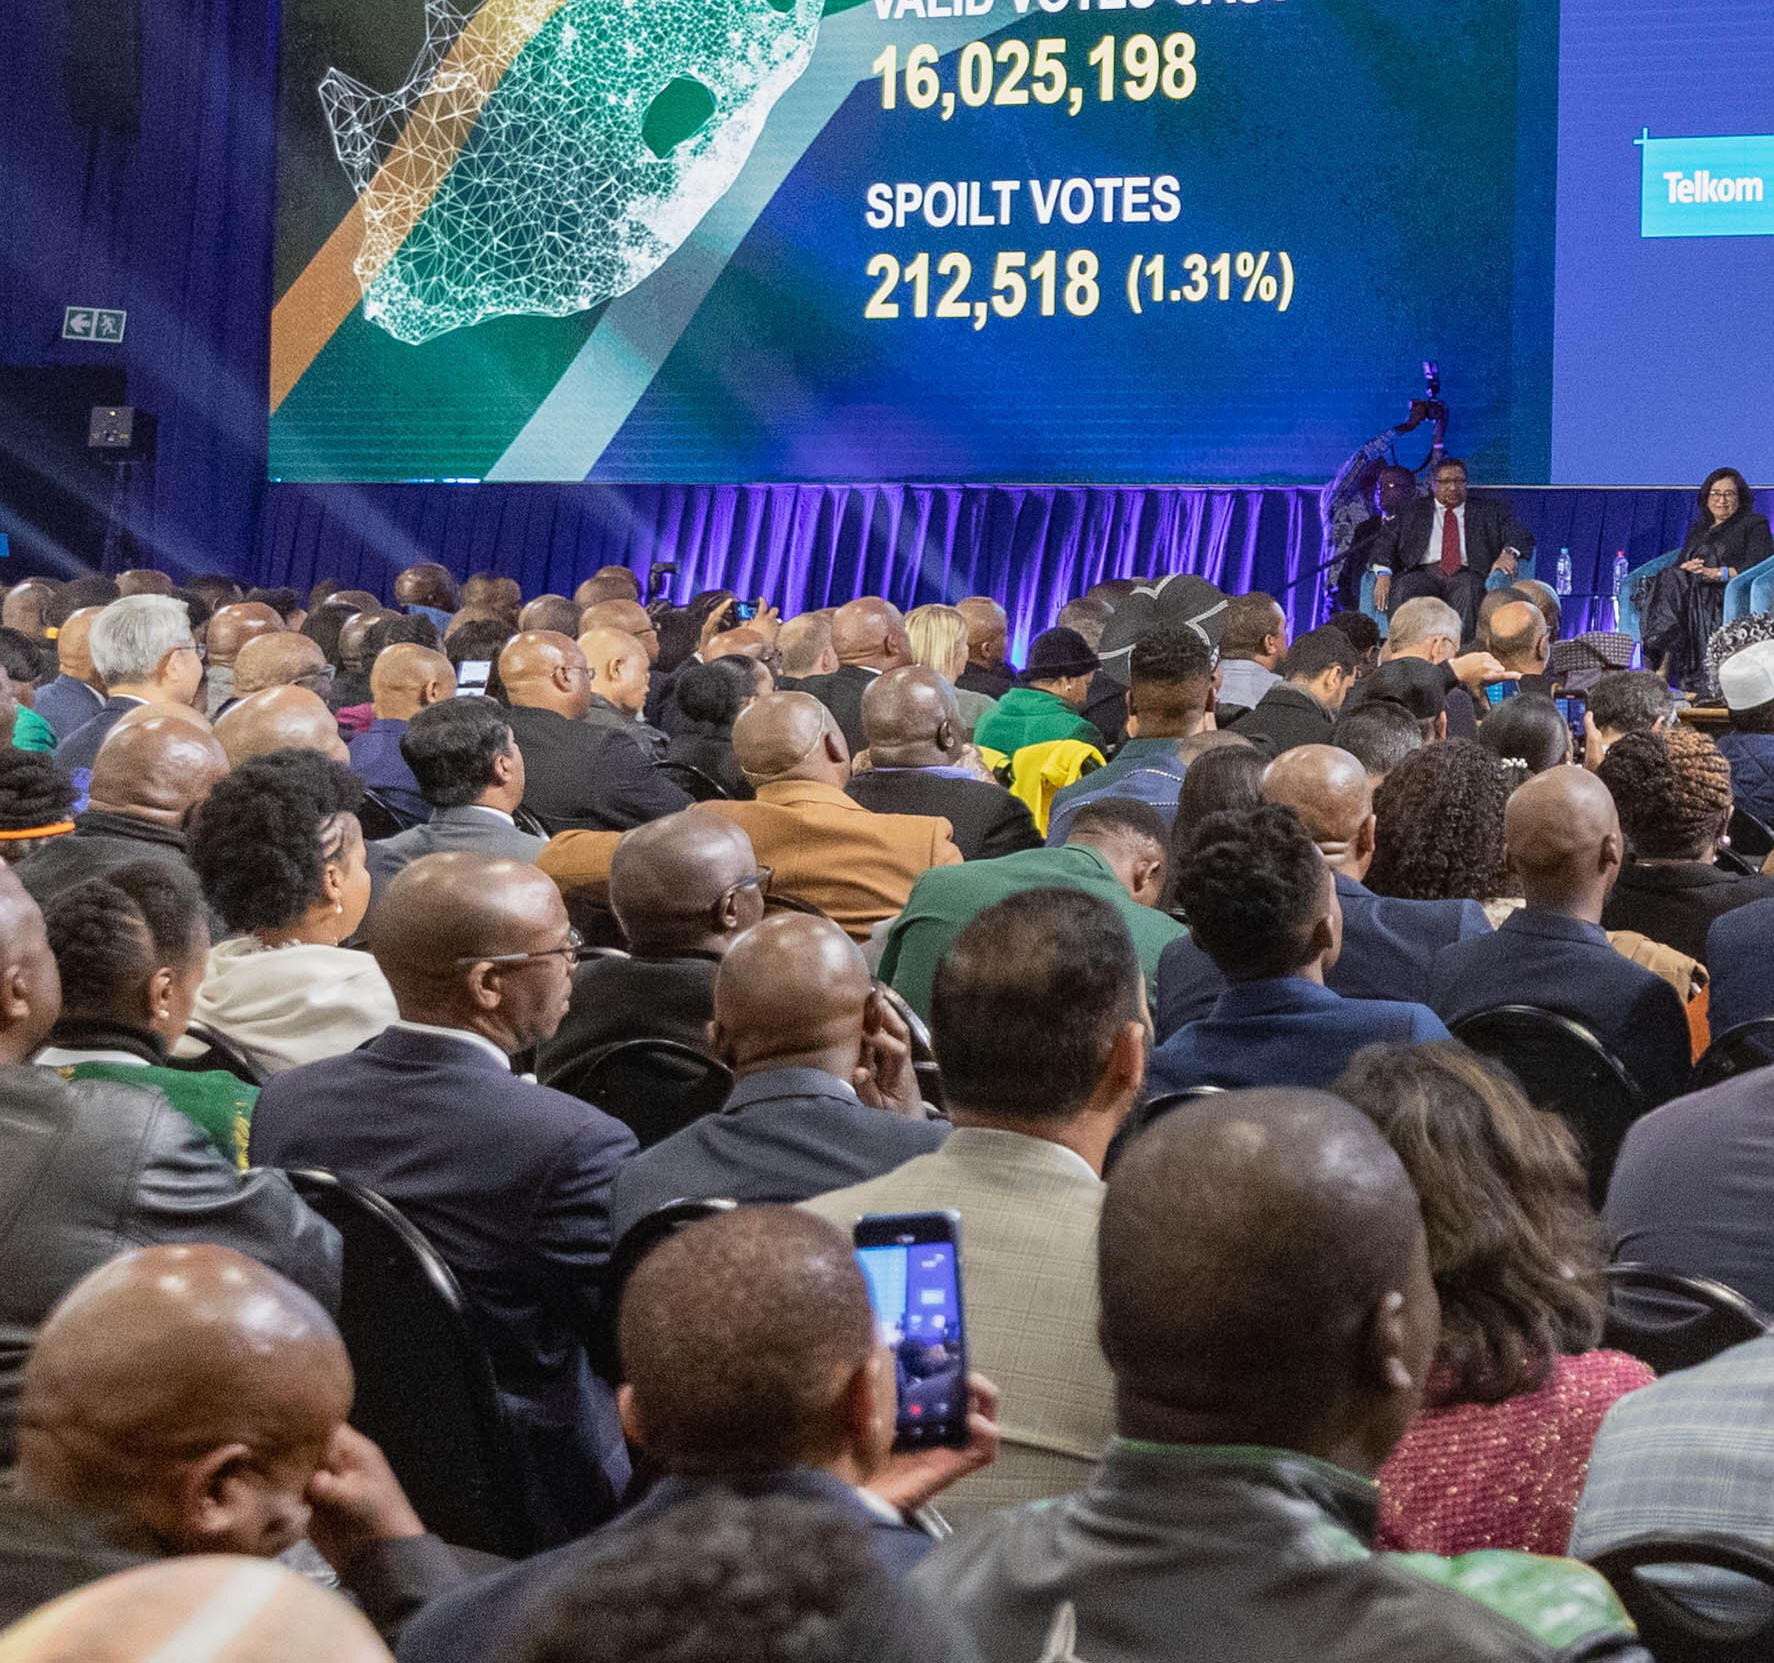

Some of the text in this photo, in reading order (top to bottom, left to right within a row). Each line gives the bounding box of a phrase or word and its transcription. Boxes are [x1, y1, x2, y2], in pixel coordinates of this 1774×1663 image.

[871, 30, 1198, 121] 16,025,198
[866, 175, 1180, 228] SPOILT VOTES
[1664, 172, 1764, 204] Telkom
[864, 250, 1294, 331] 212,518 (1.31%)
